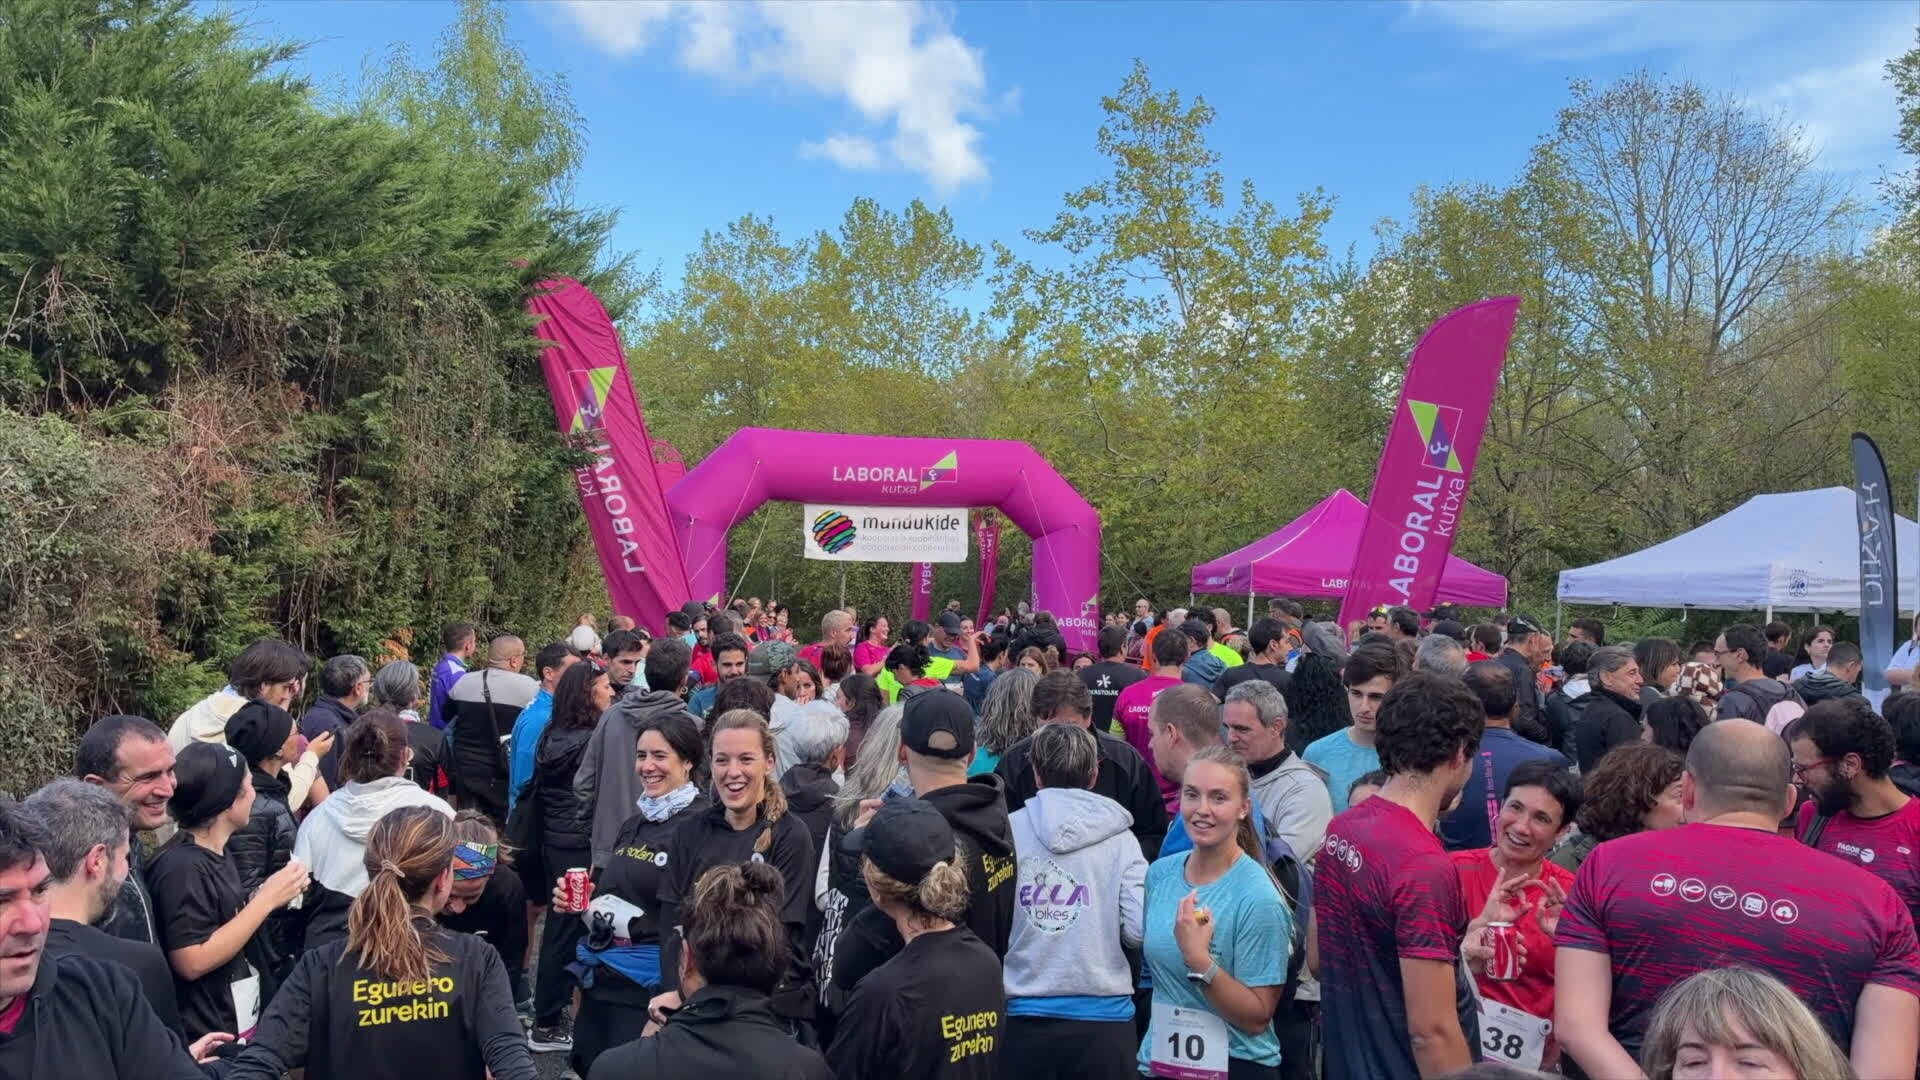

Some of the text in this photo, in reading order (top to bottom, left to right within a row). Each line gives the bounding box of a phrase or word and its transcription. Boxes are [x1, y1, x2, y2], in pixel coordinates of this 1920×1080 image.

[832, 466, 918, 483] LABORAL
[881, 484, 918, 495] kutxa
[1433, 478, 1465, 537] kutxa
[862, 514, 960, 531] mundukide
[1057, 617, 1097, 629] ABORAL
[1020, 884, 1090, 907] ELLA
[1034, 906, 1069, 921] bikes
[358, 996, 449, 1027] zurekin
[941, 1010, 998, 1041] Egunero
[1168, 1031, 1205, 1061] 10
[1482, 1026, 1525, 1060] 38
